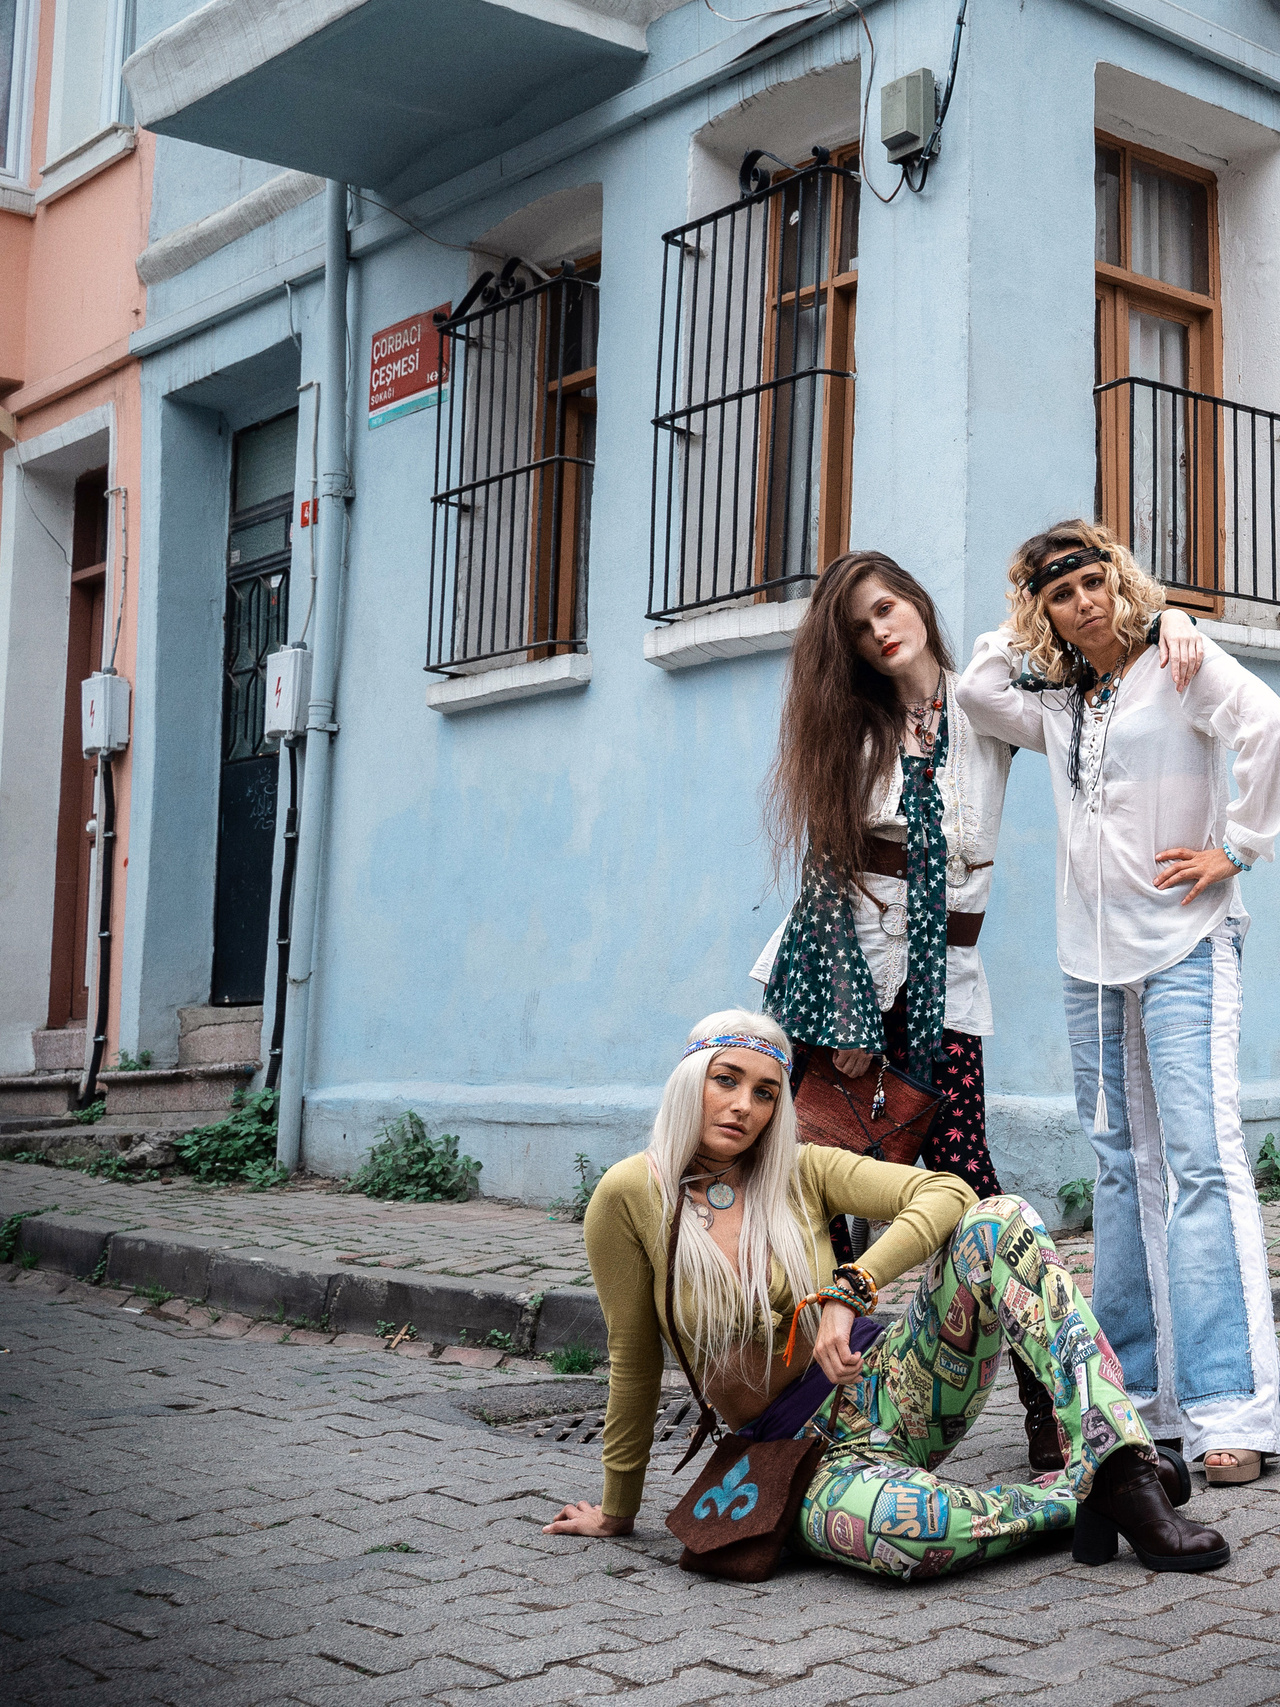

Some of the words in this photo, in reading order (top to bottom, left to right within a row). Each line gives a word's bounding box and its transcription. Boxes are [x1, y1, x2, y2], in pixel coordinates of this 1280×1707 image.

[372, 348, 420, 391] ÇEŞMESİ
[1006, 1228, 1034, 1267] OMO
[940, 1356, 967, 1375] DUCA
[880, 1482, 921, 1538] Surf
